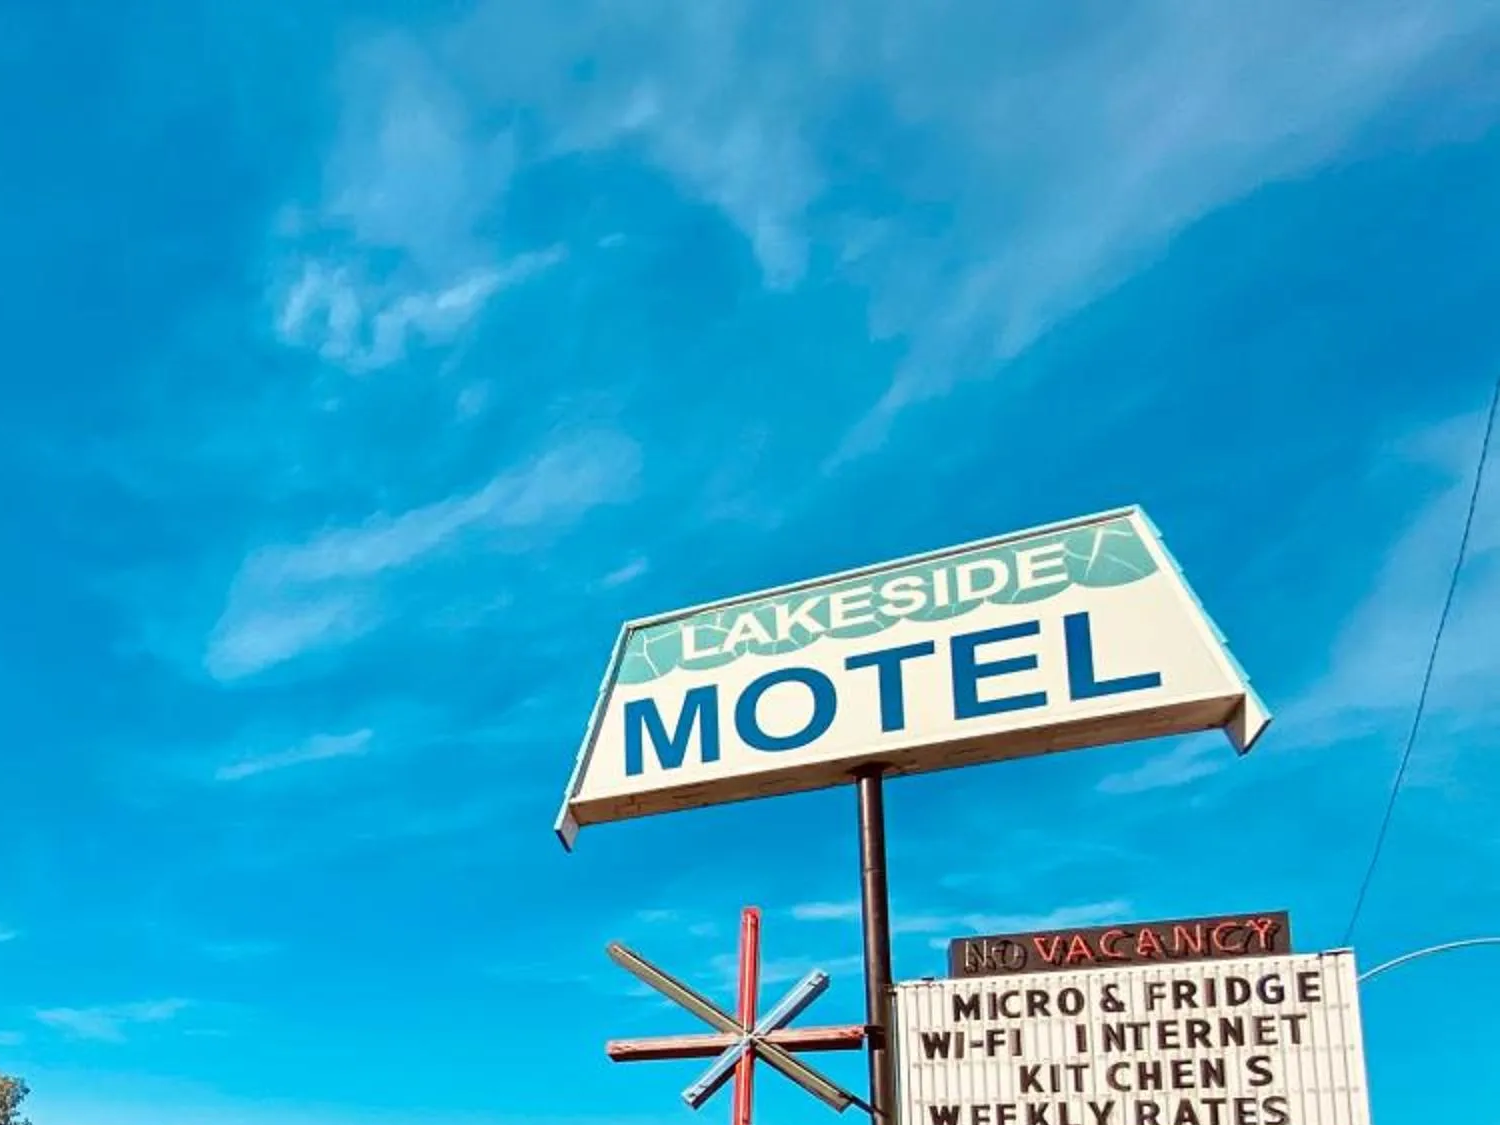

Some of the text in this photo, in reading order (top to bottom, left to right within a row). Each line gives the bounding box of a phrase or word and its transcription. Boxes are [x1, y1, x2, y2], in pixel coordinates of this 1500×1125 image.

[681, 543, 1068, 660] LAKESIDE
[624, 612, 1162, 776] MOTEL
[964, 918, 1274, 970] NO VACANCY
[953, 971, 1321, 1022] MICRO & FRIDGE
[921, 1014, 1307, 1060] WI-FI INTERNET
[1020, 1056, 1273, 1093] KITCHENS
